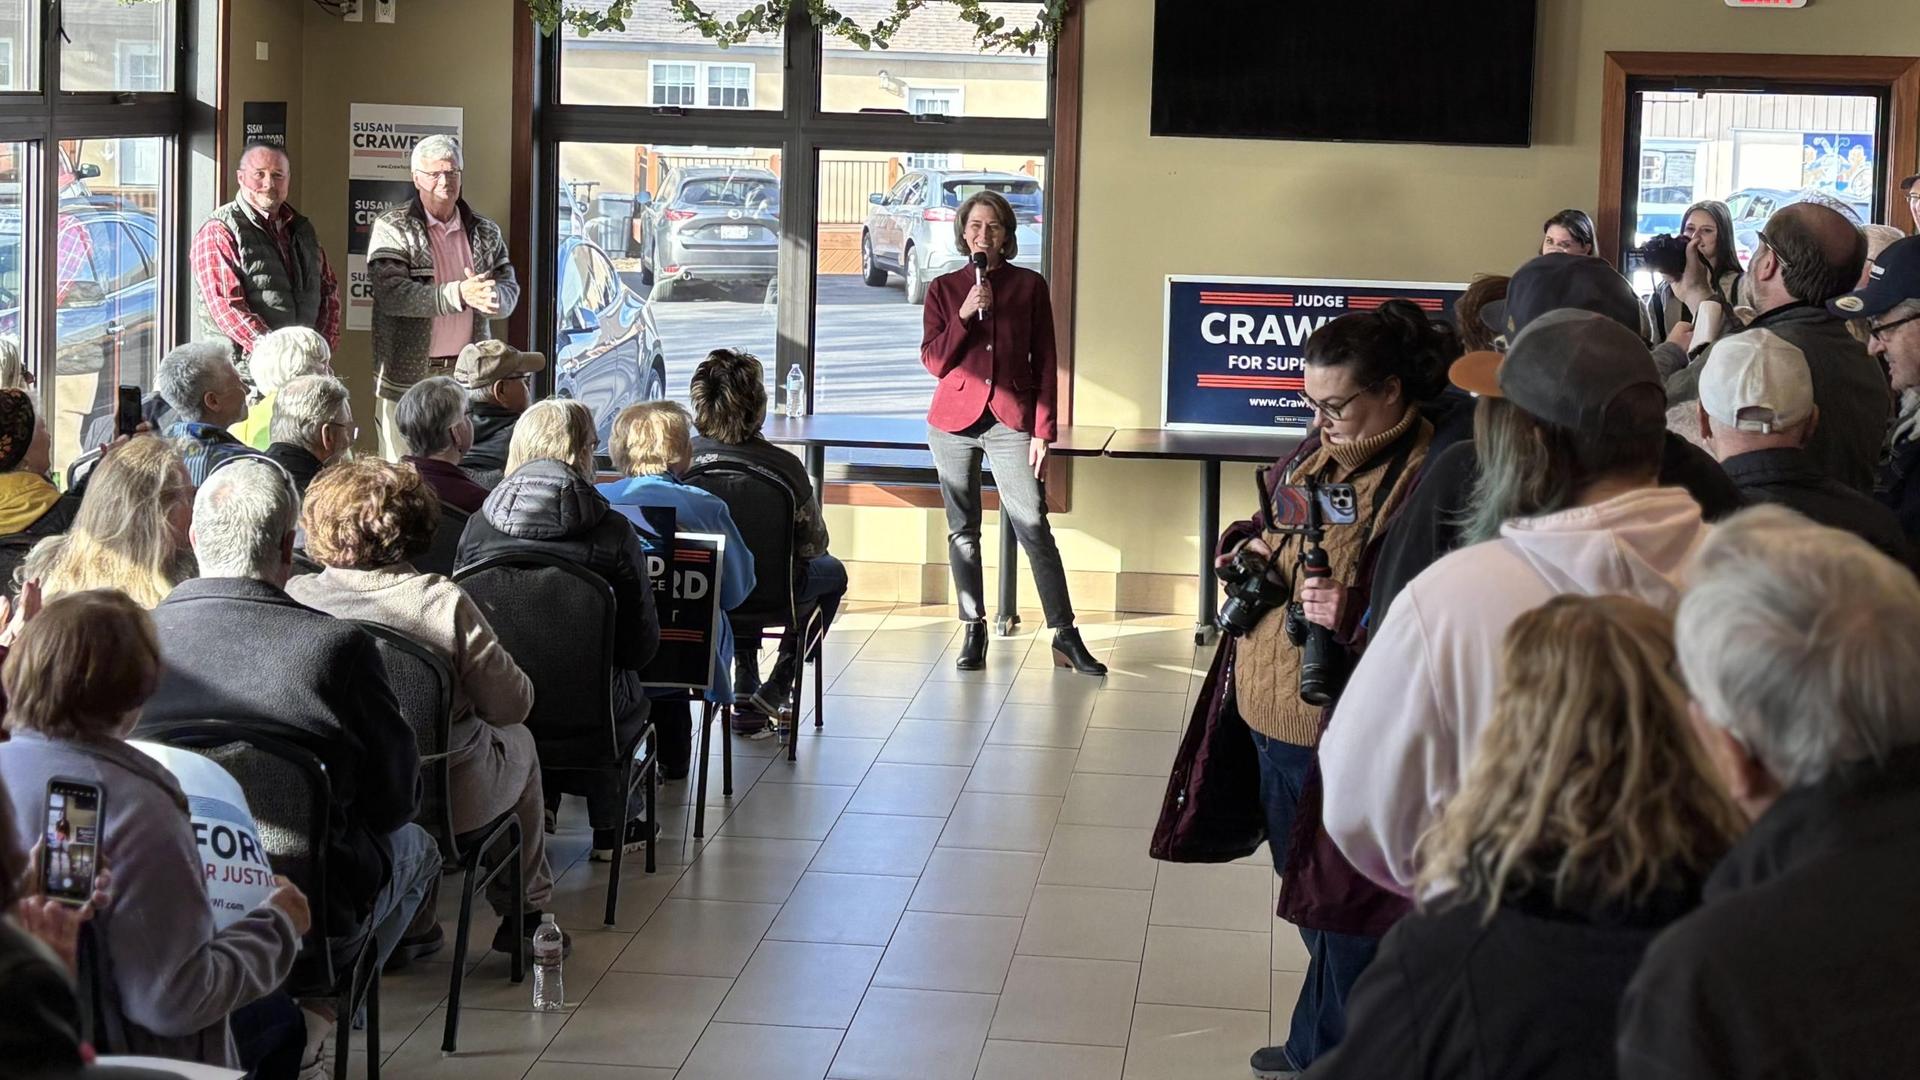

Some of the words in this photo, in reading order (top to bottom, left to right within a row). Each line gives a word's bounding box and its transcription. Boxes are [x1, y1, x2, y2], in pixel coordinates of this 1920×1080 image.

[353, 122, 393, 133] SUSAN
[354, 200, 393, 210] SUSAN
[1294, 294, 1345, 308] JUDGE
[1200, 312, 1337, 347] CRAW
[1228, 355, 1263, 370] FOR
[1249, 397, 1311, 408] www.Craw
[191, 823, 268, 868] FOR
